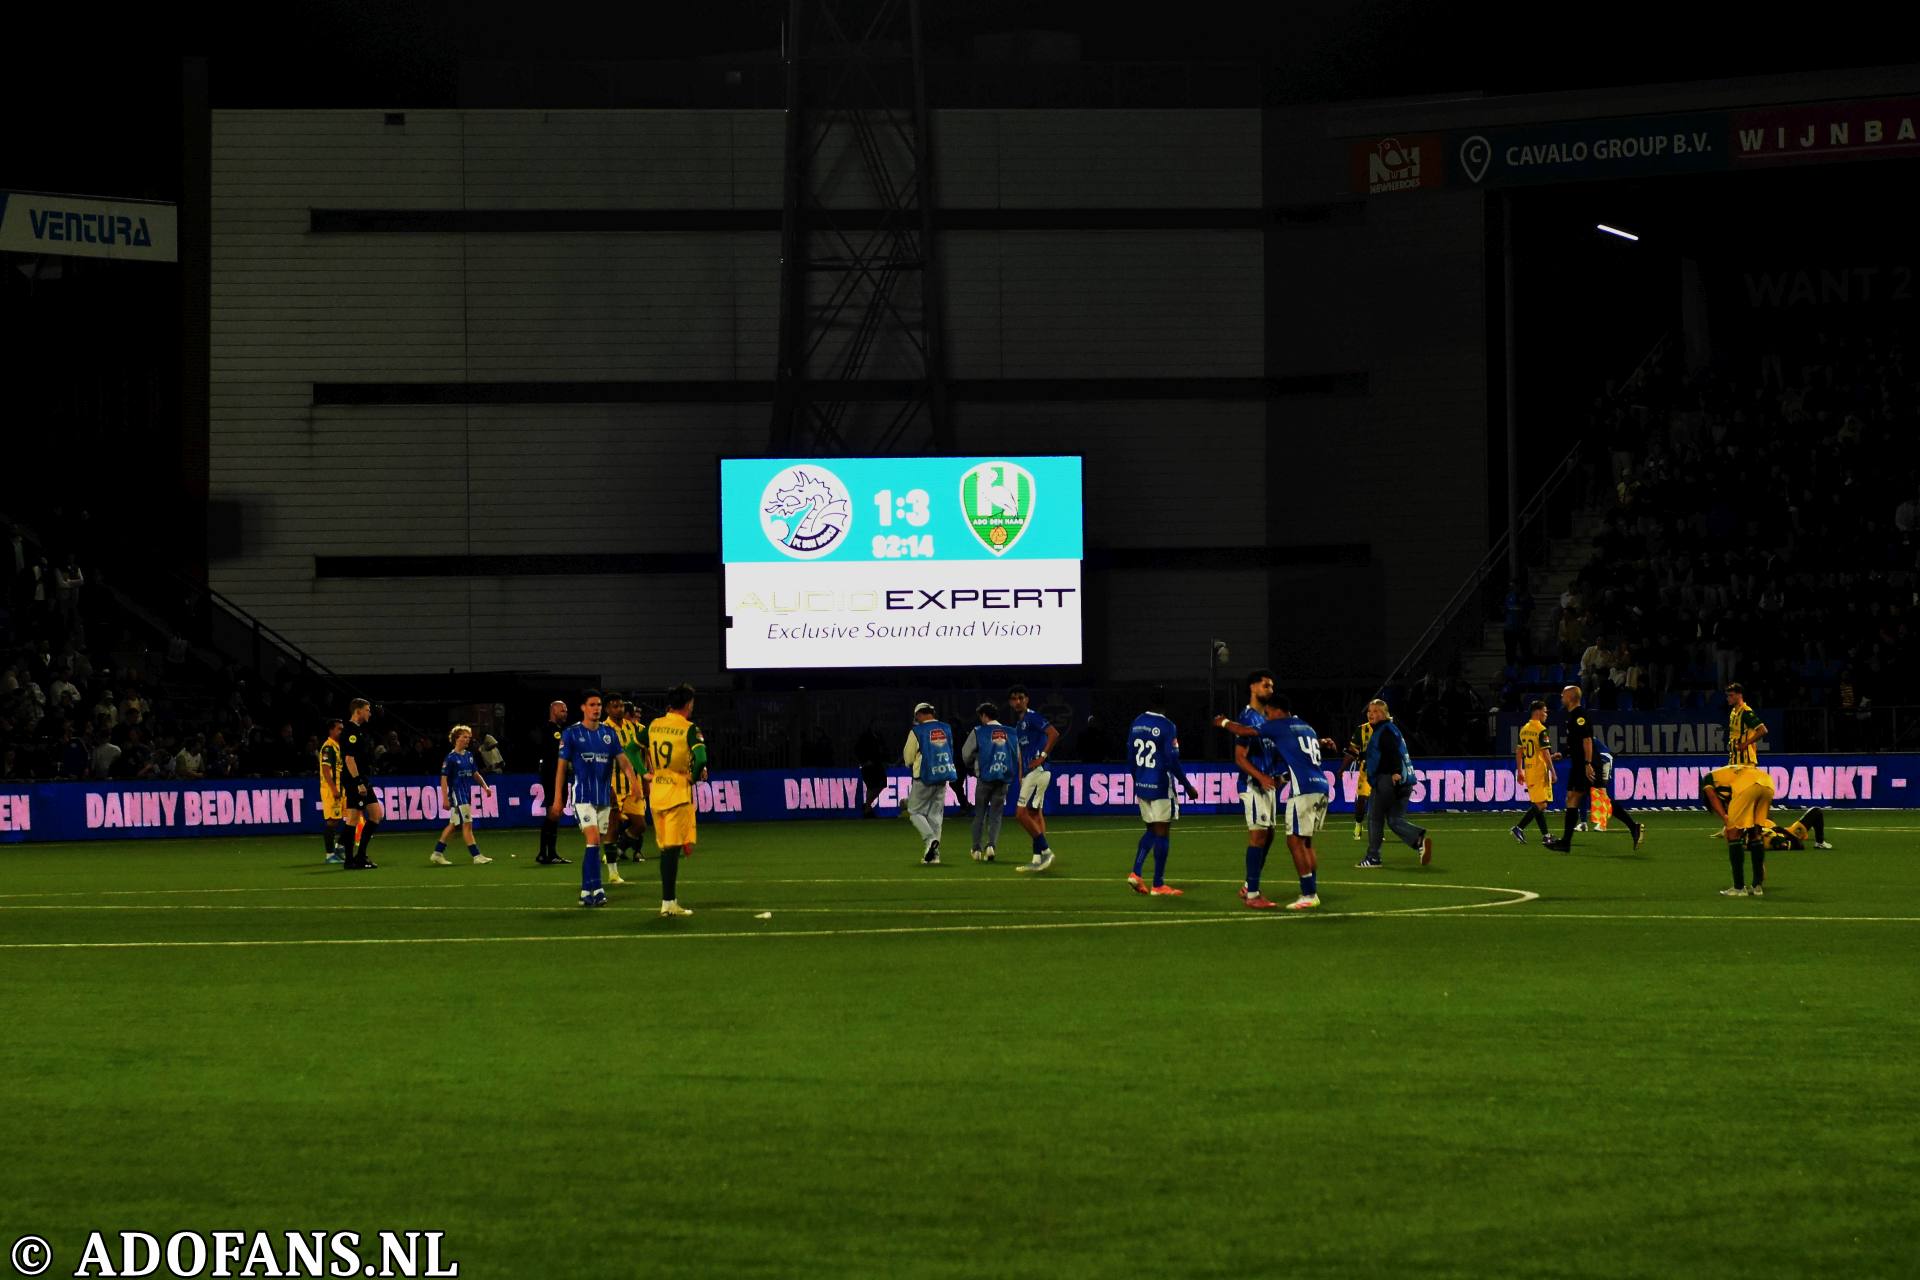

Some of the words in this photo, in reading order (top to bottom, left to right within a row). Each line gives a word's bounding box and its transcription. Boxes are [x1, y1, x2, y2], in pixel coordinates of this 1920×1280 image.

[1505, 141, 1588, 167] CAVALO
[1593, 135, 1668, 160] GROUP
[1673, 132, 1712, 155] B.V.
[30, 209, 151, 247] VENTURA
[1744, 265, 1881, 309] WANT
[874, 488, 930, 527] 1:3
[767, 622, 859, 640] Exclusive
[865, 621, 930, 638] Sound
[935, 620, 976, 637] and
[982, 620, 1042, 637] Vision
[653, 740, 673, 769] 19
[1133, 738, 1157, 769] 22
[1298, 735, 1322, 767] 46
[784, 777, 858, 810] DANNY
[1056, 773, 1083, 805] 11
[1614, 766, 1713, 801] DANN
[85, 791, 179, 829] DANNY
[184, 788, 304, 826] BEDANKT
